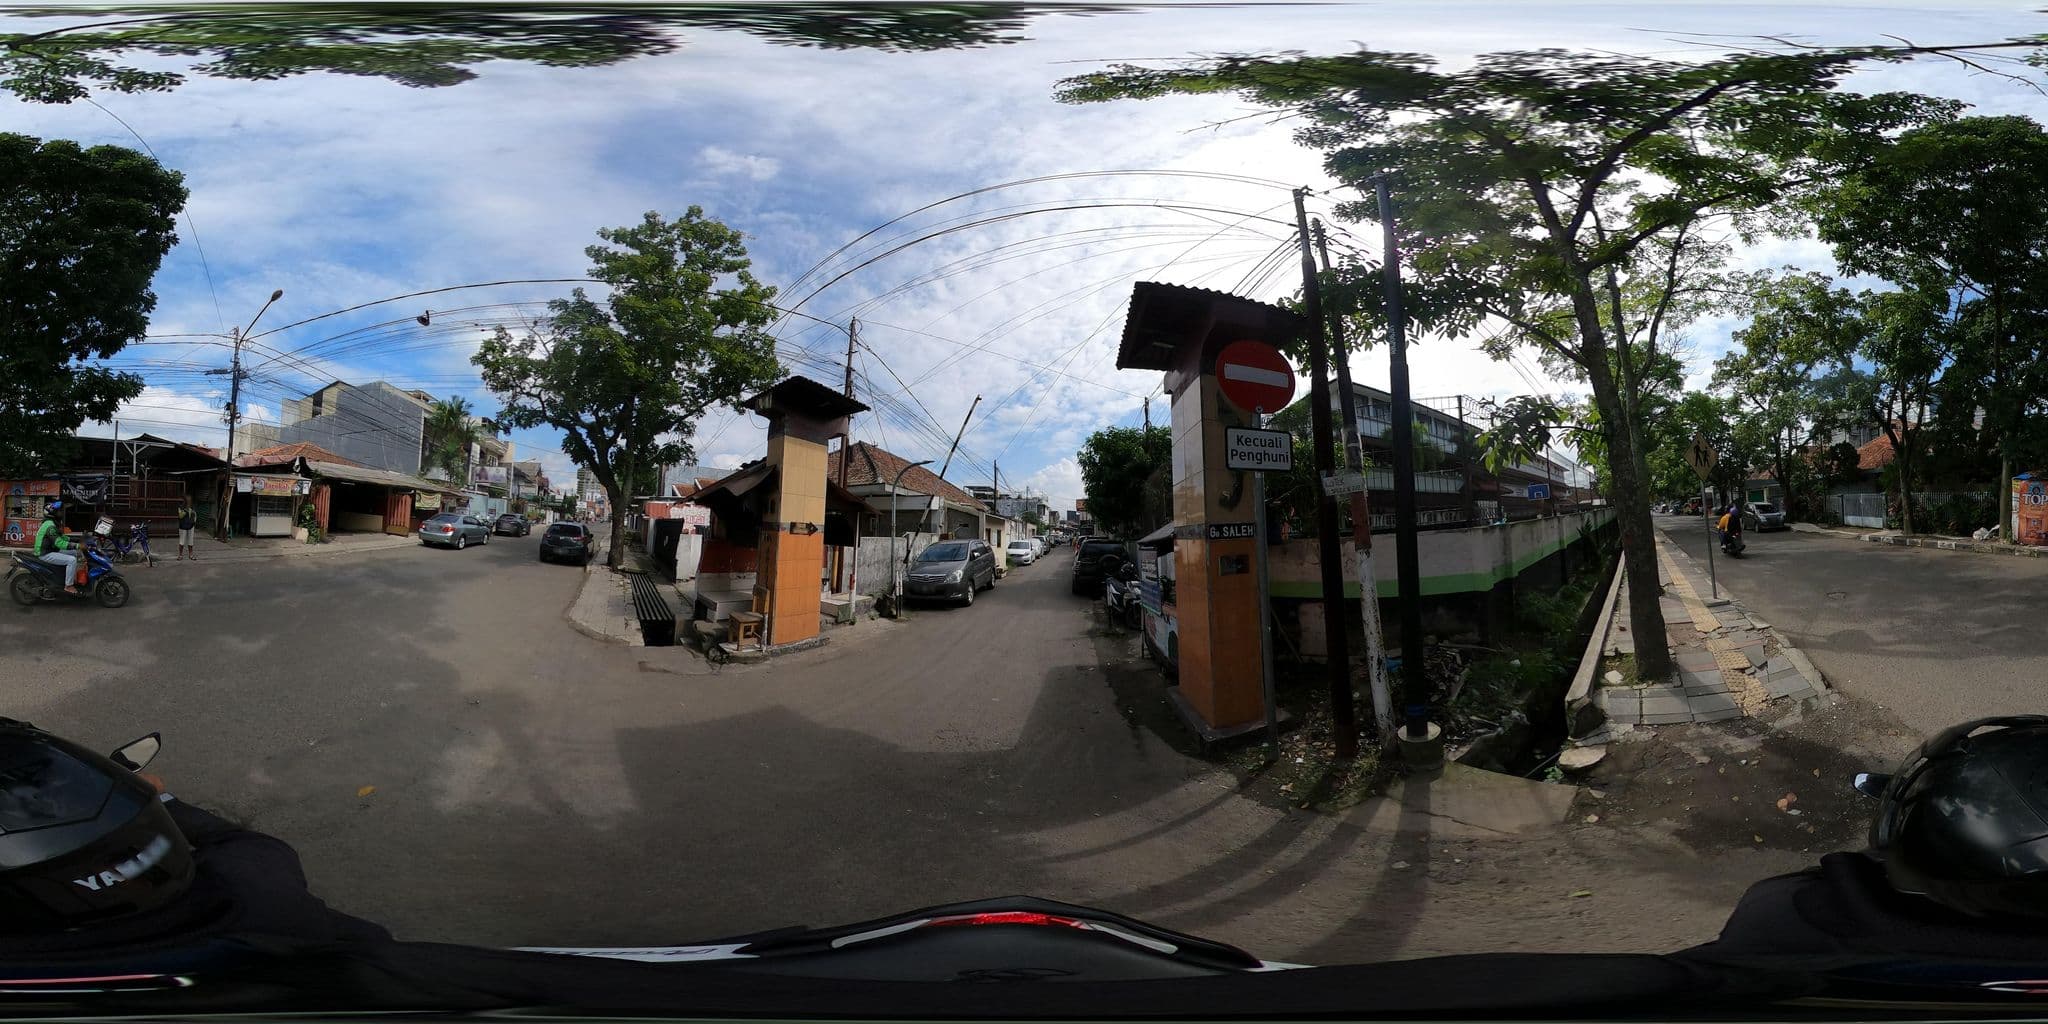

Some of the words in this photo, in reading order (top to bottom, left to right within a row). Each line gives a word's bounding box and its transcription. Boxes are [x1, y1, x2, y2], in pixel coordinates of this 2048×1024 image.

[1236, 434, 1282, 449] Kecuali
[1230, 448, 1289, 464] Penghuni
[4, 532, 25, 542] TOP
[1222, 524, 1254, 537] SALEH
